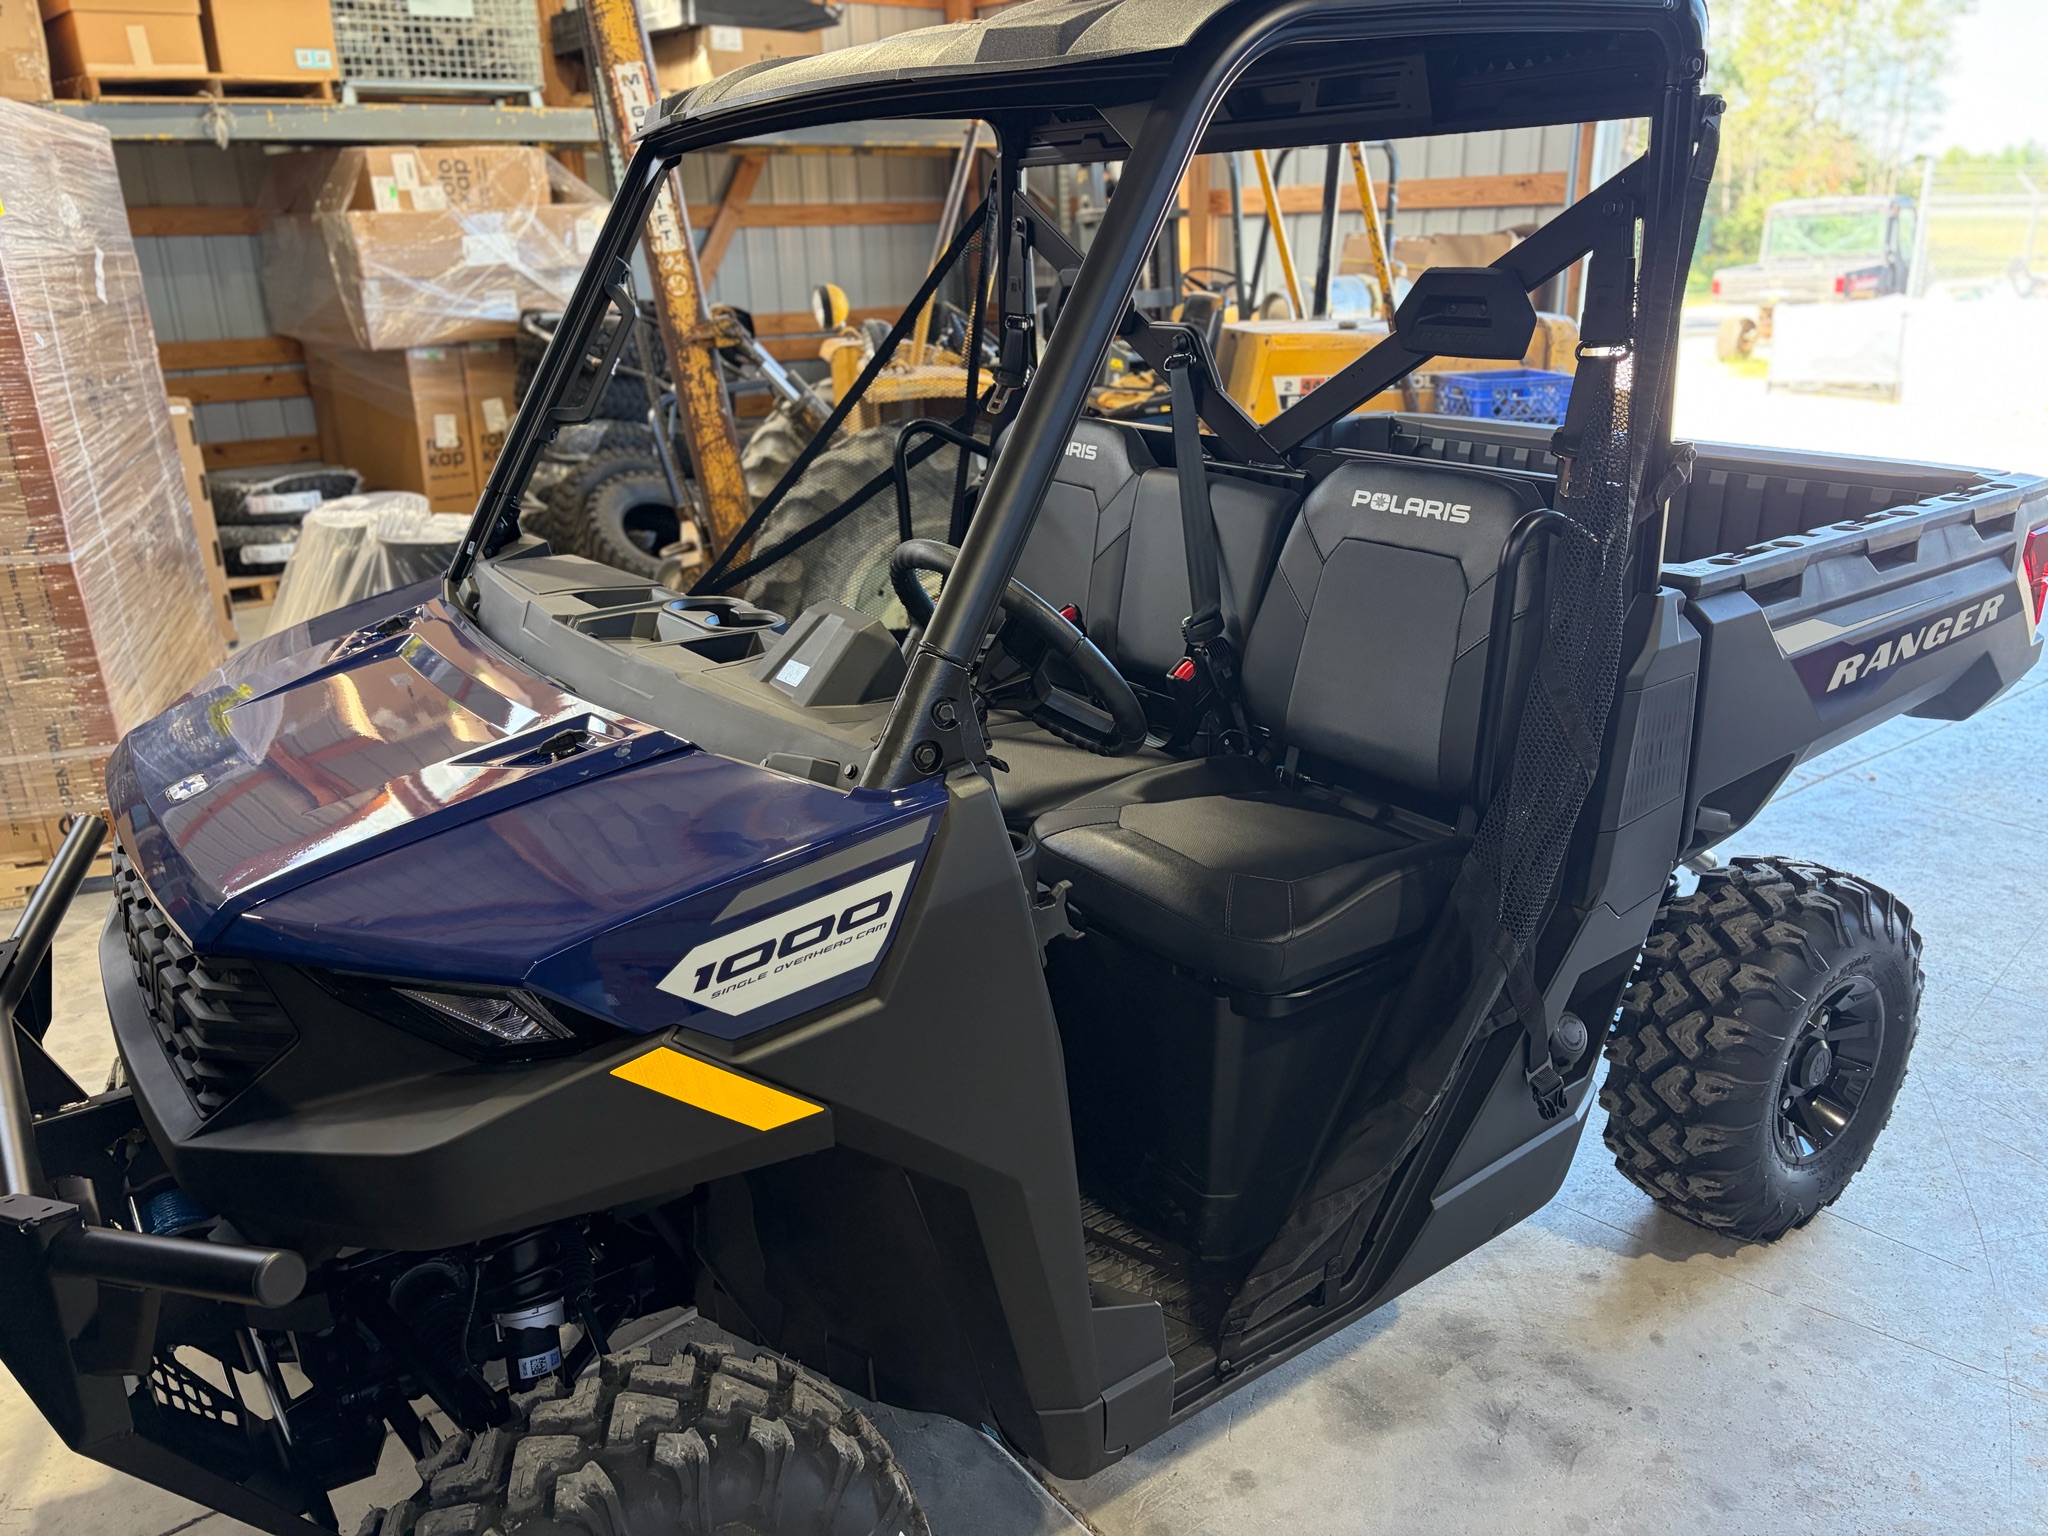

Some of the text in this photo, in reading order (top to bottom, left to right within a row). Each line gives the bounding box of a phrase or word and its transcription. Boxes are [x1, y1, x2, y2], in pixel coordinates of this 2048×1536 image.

[1351, 489, 1472, 525] POLARIS
[1826, 593, 2005, 693] RANGER
[693, 890, 893, 994] 1000
[710, 921, 887, 1000] SINGLE OVERHEAD CAM
